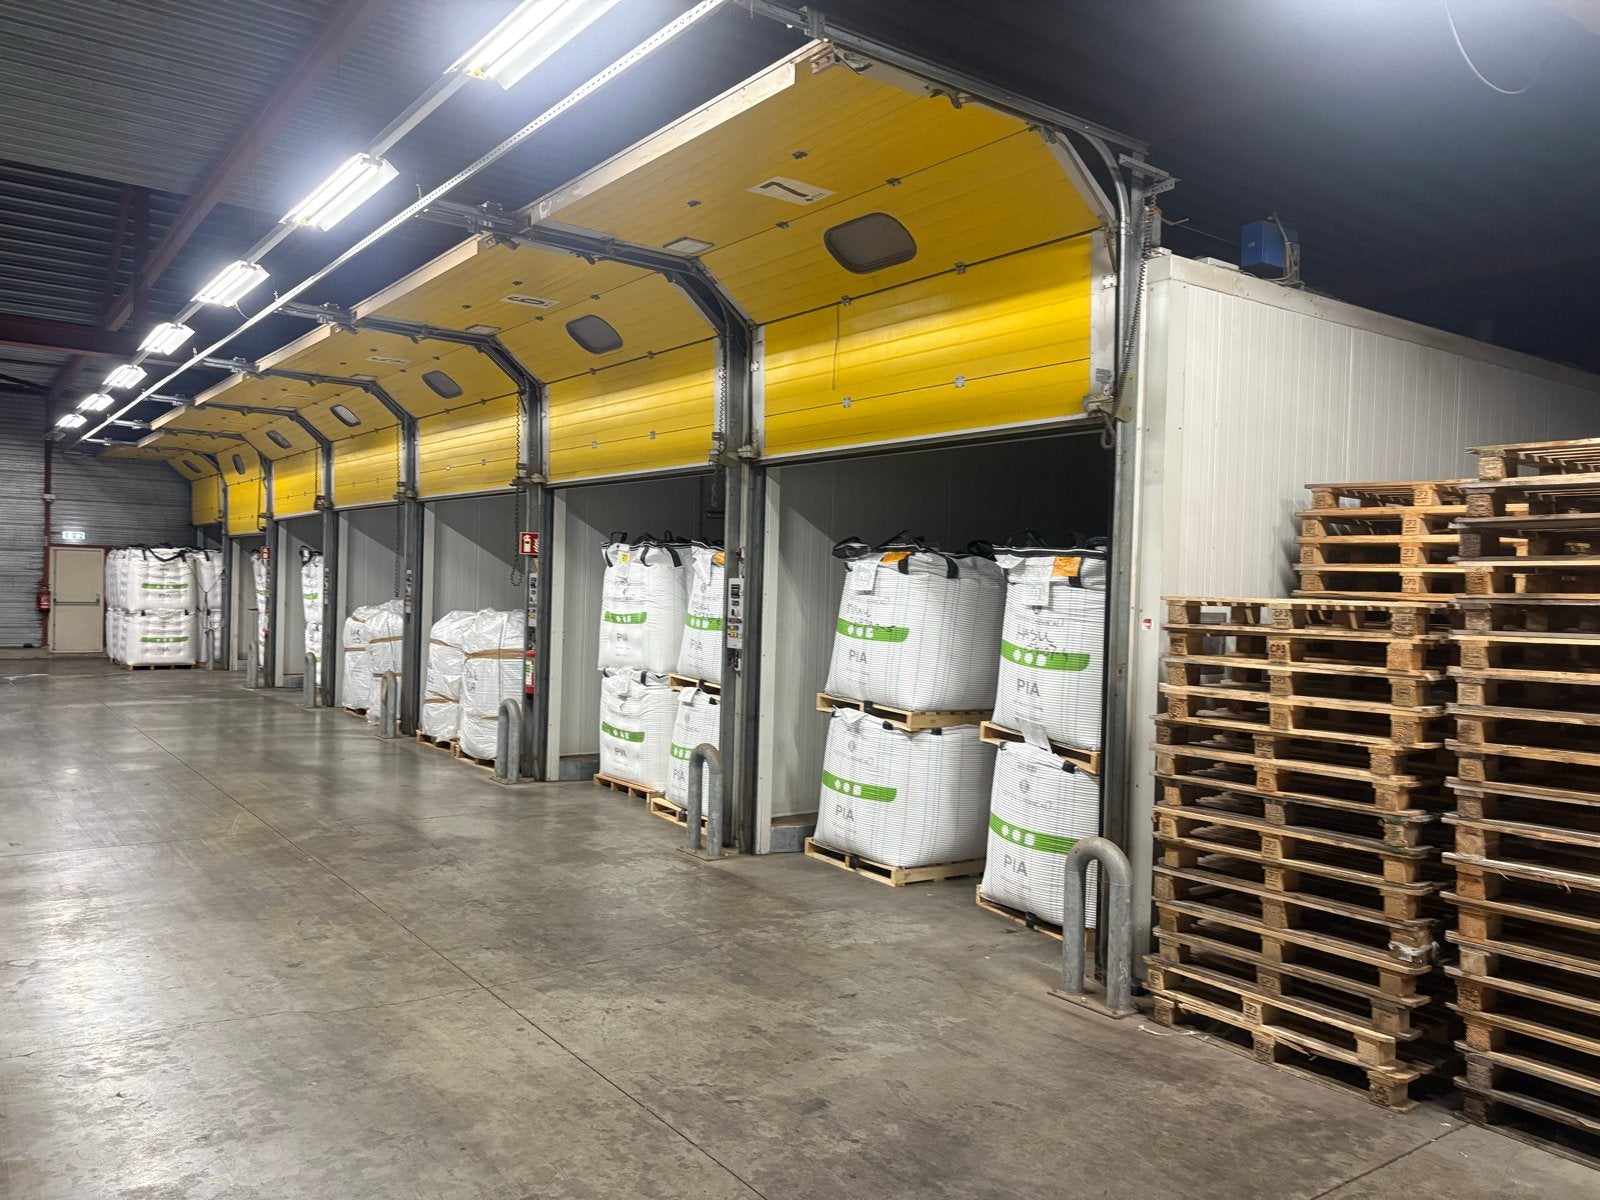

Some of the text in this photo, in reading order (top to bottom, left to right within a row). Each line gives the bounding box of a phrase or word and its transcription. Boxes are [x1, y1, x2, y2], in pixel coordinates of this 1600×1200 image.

[759, 181, 810, 198] 7
[507, 296, 545, 304] 6
[849, 649, 867, 664] PIA
[1270, 644, 1286, 653] CP3
[1017, 678, 1040, 697] PIA
[835, 804, 854, 821] PIA
[1003, 854, 1027, 876] PIA
